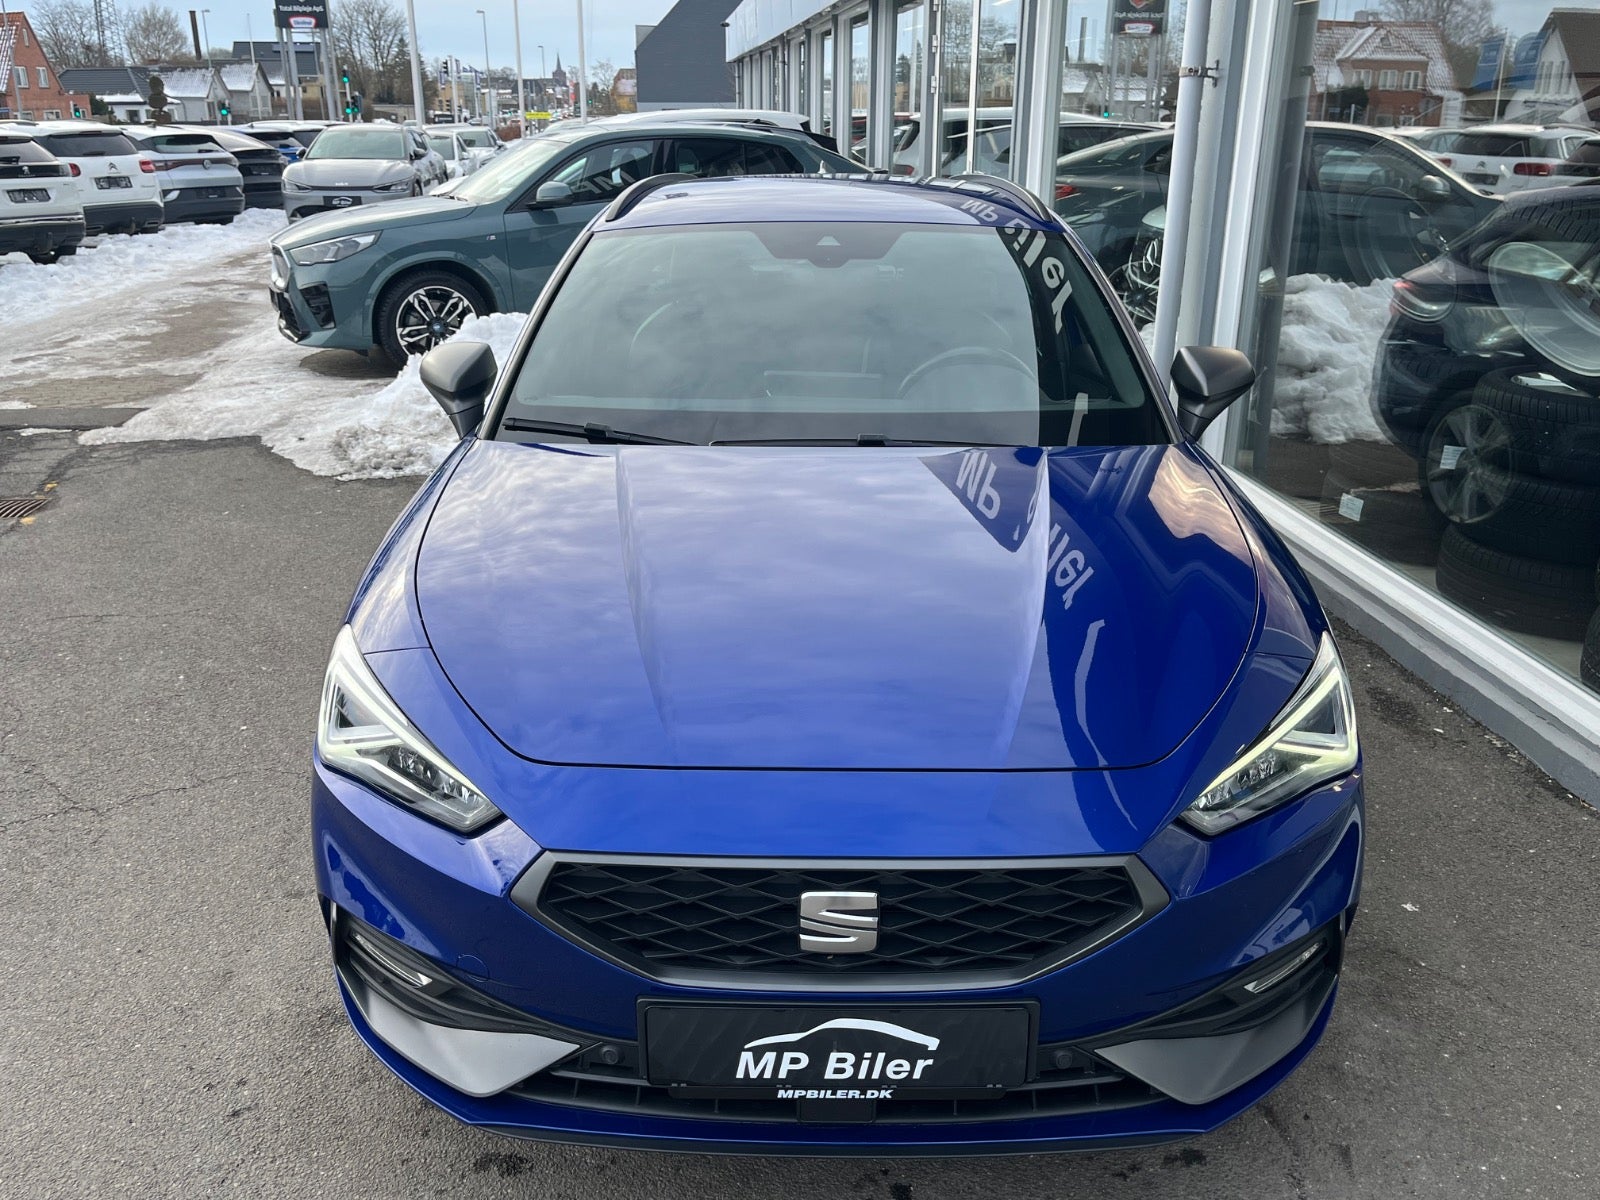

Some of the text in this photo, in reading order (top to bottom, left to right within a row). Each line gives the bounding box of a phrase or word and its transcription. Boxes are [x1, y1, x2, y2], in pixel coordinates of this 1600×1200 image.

[735, 1051, 933, 1080] MP Biler
[777, 1089, 894, 1100] MPBILER.DK
